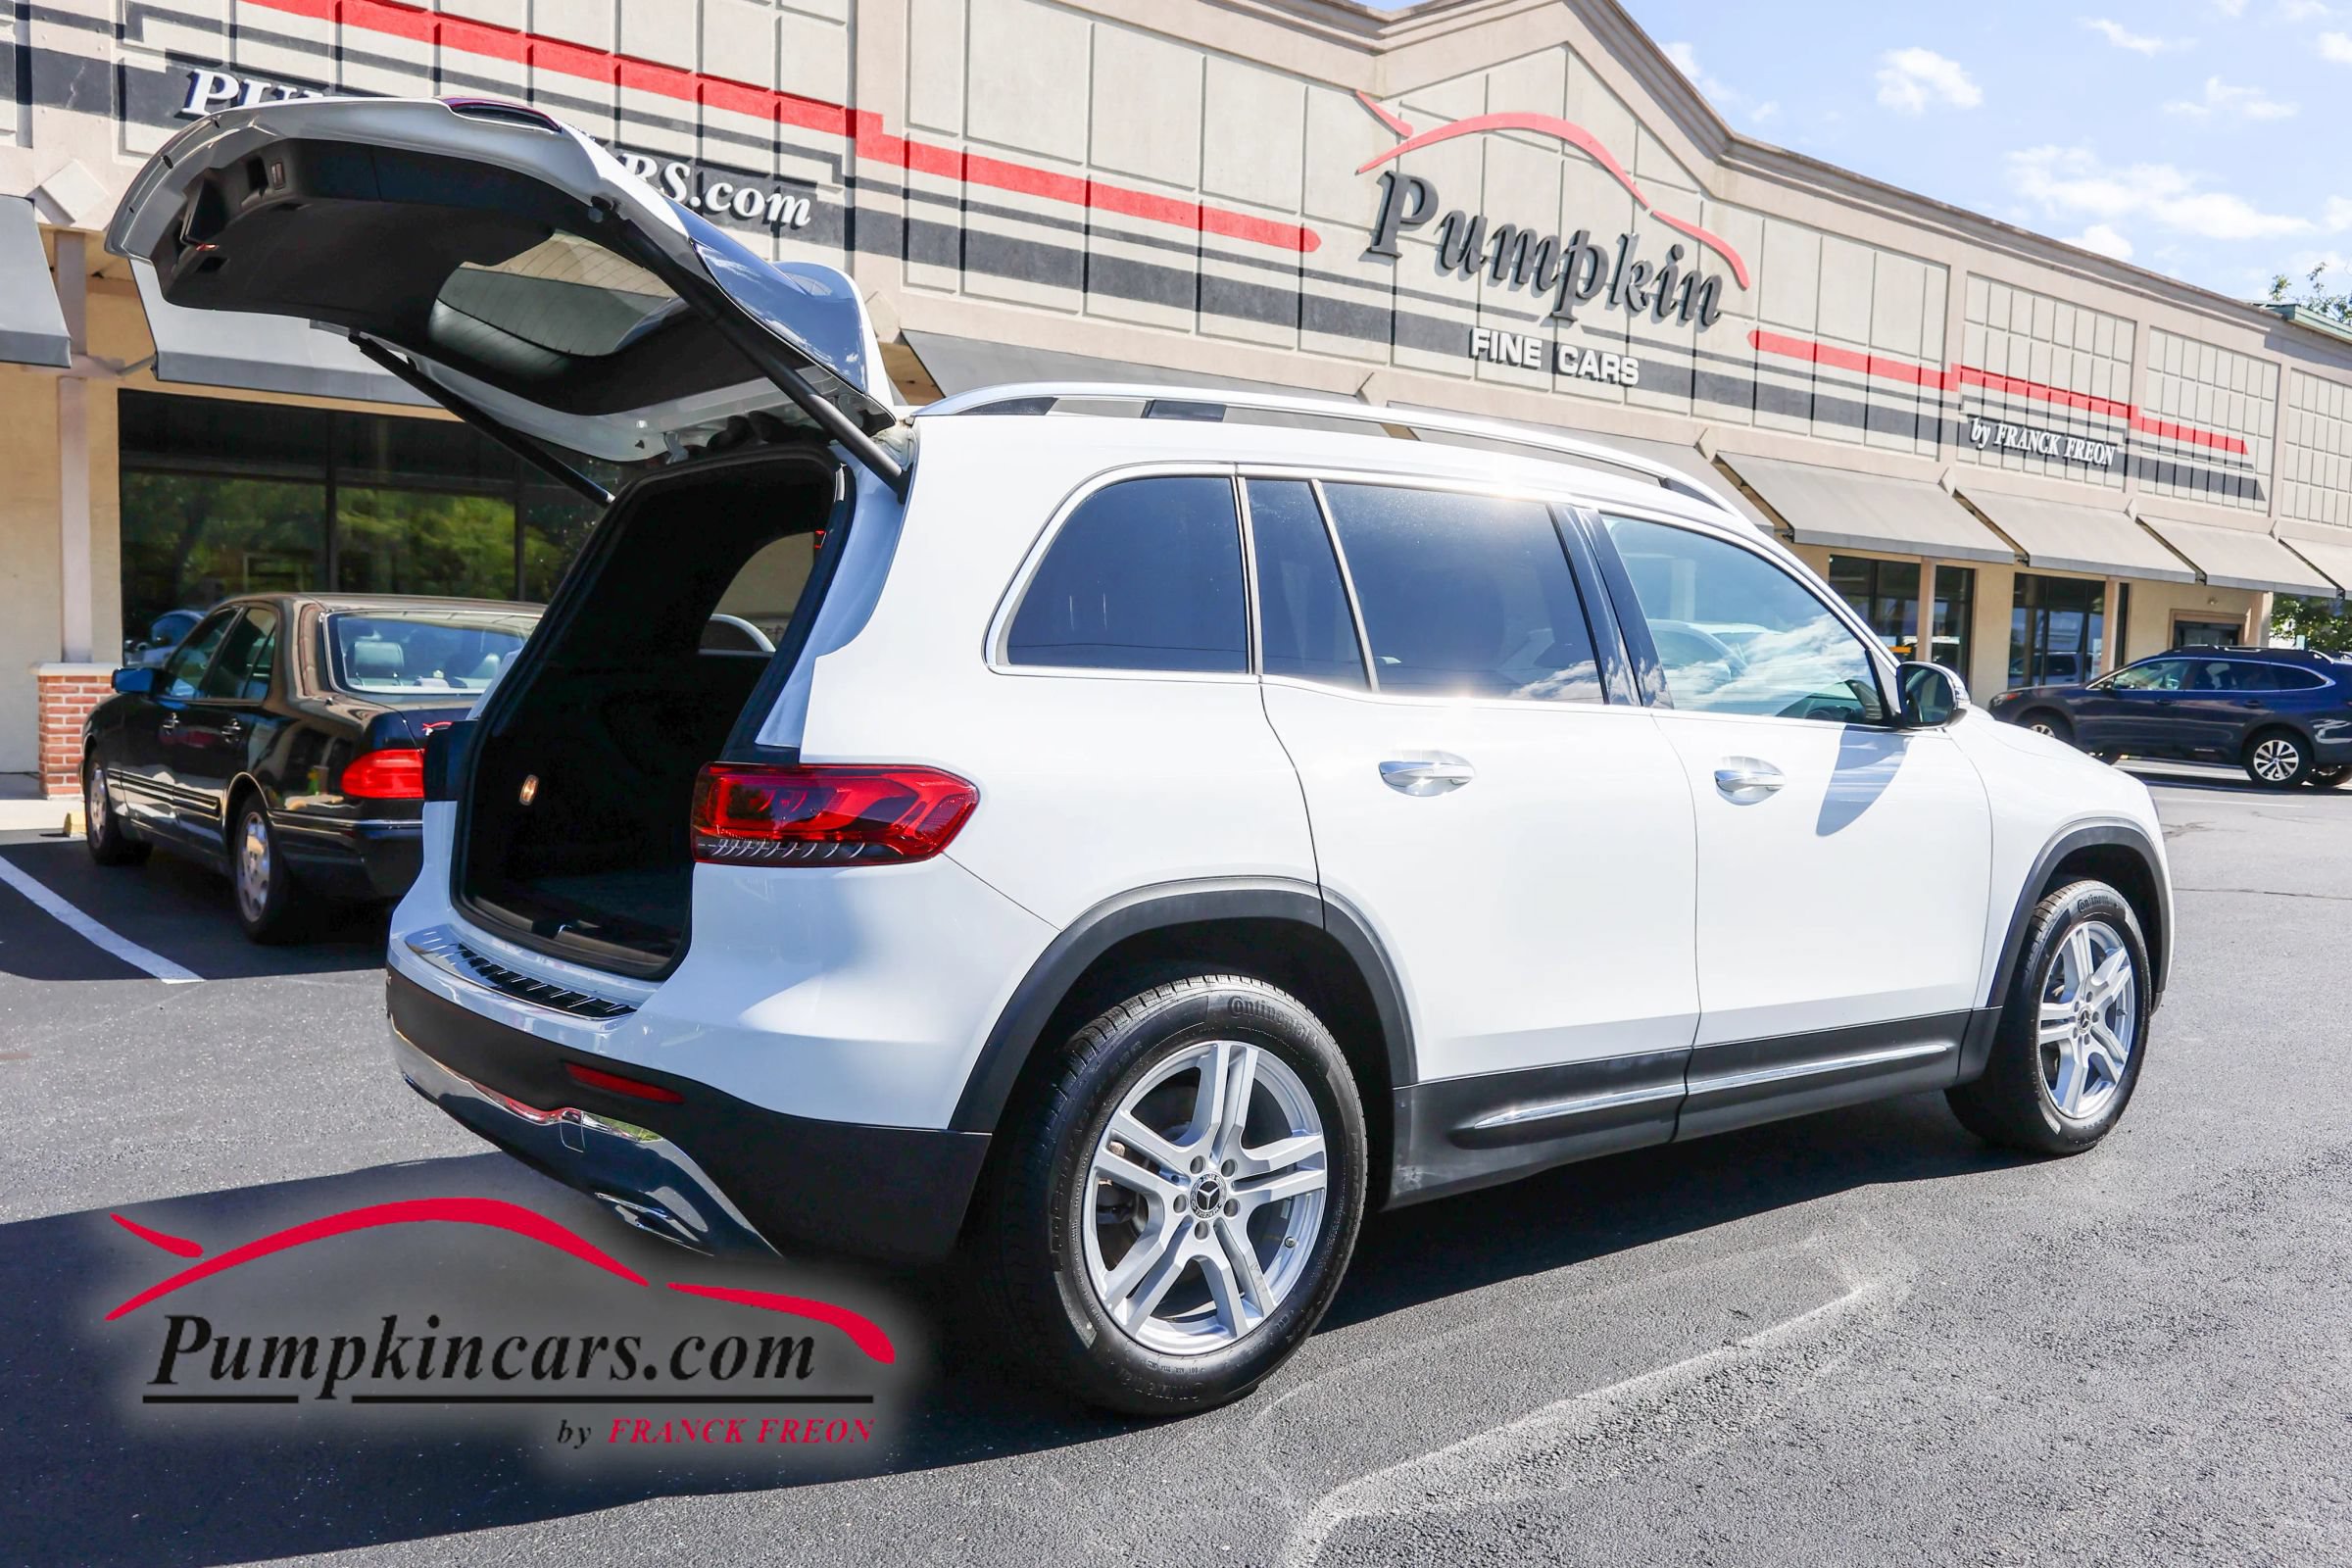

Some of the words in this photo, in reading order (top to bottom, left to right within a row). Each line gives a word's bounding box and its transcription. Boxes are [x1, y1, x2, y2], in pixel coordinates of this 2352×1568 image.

[1367, 171, 1723, 327] Pumpkin
[1471, 327, 1543, 368] FINE
[1558, 345, 1640, 386] CARS
[1971, 417, 1991, 449] by
[1994, 422, 2060, 456] FRANCK
[2064, 436, 2117, 466] FREON
